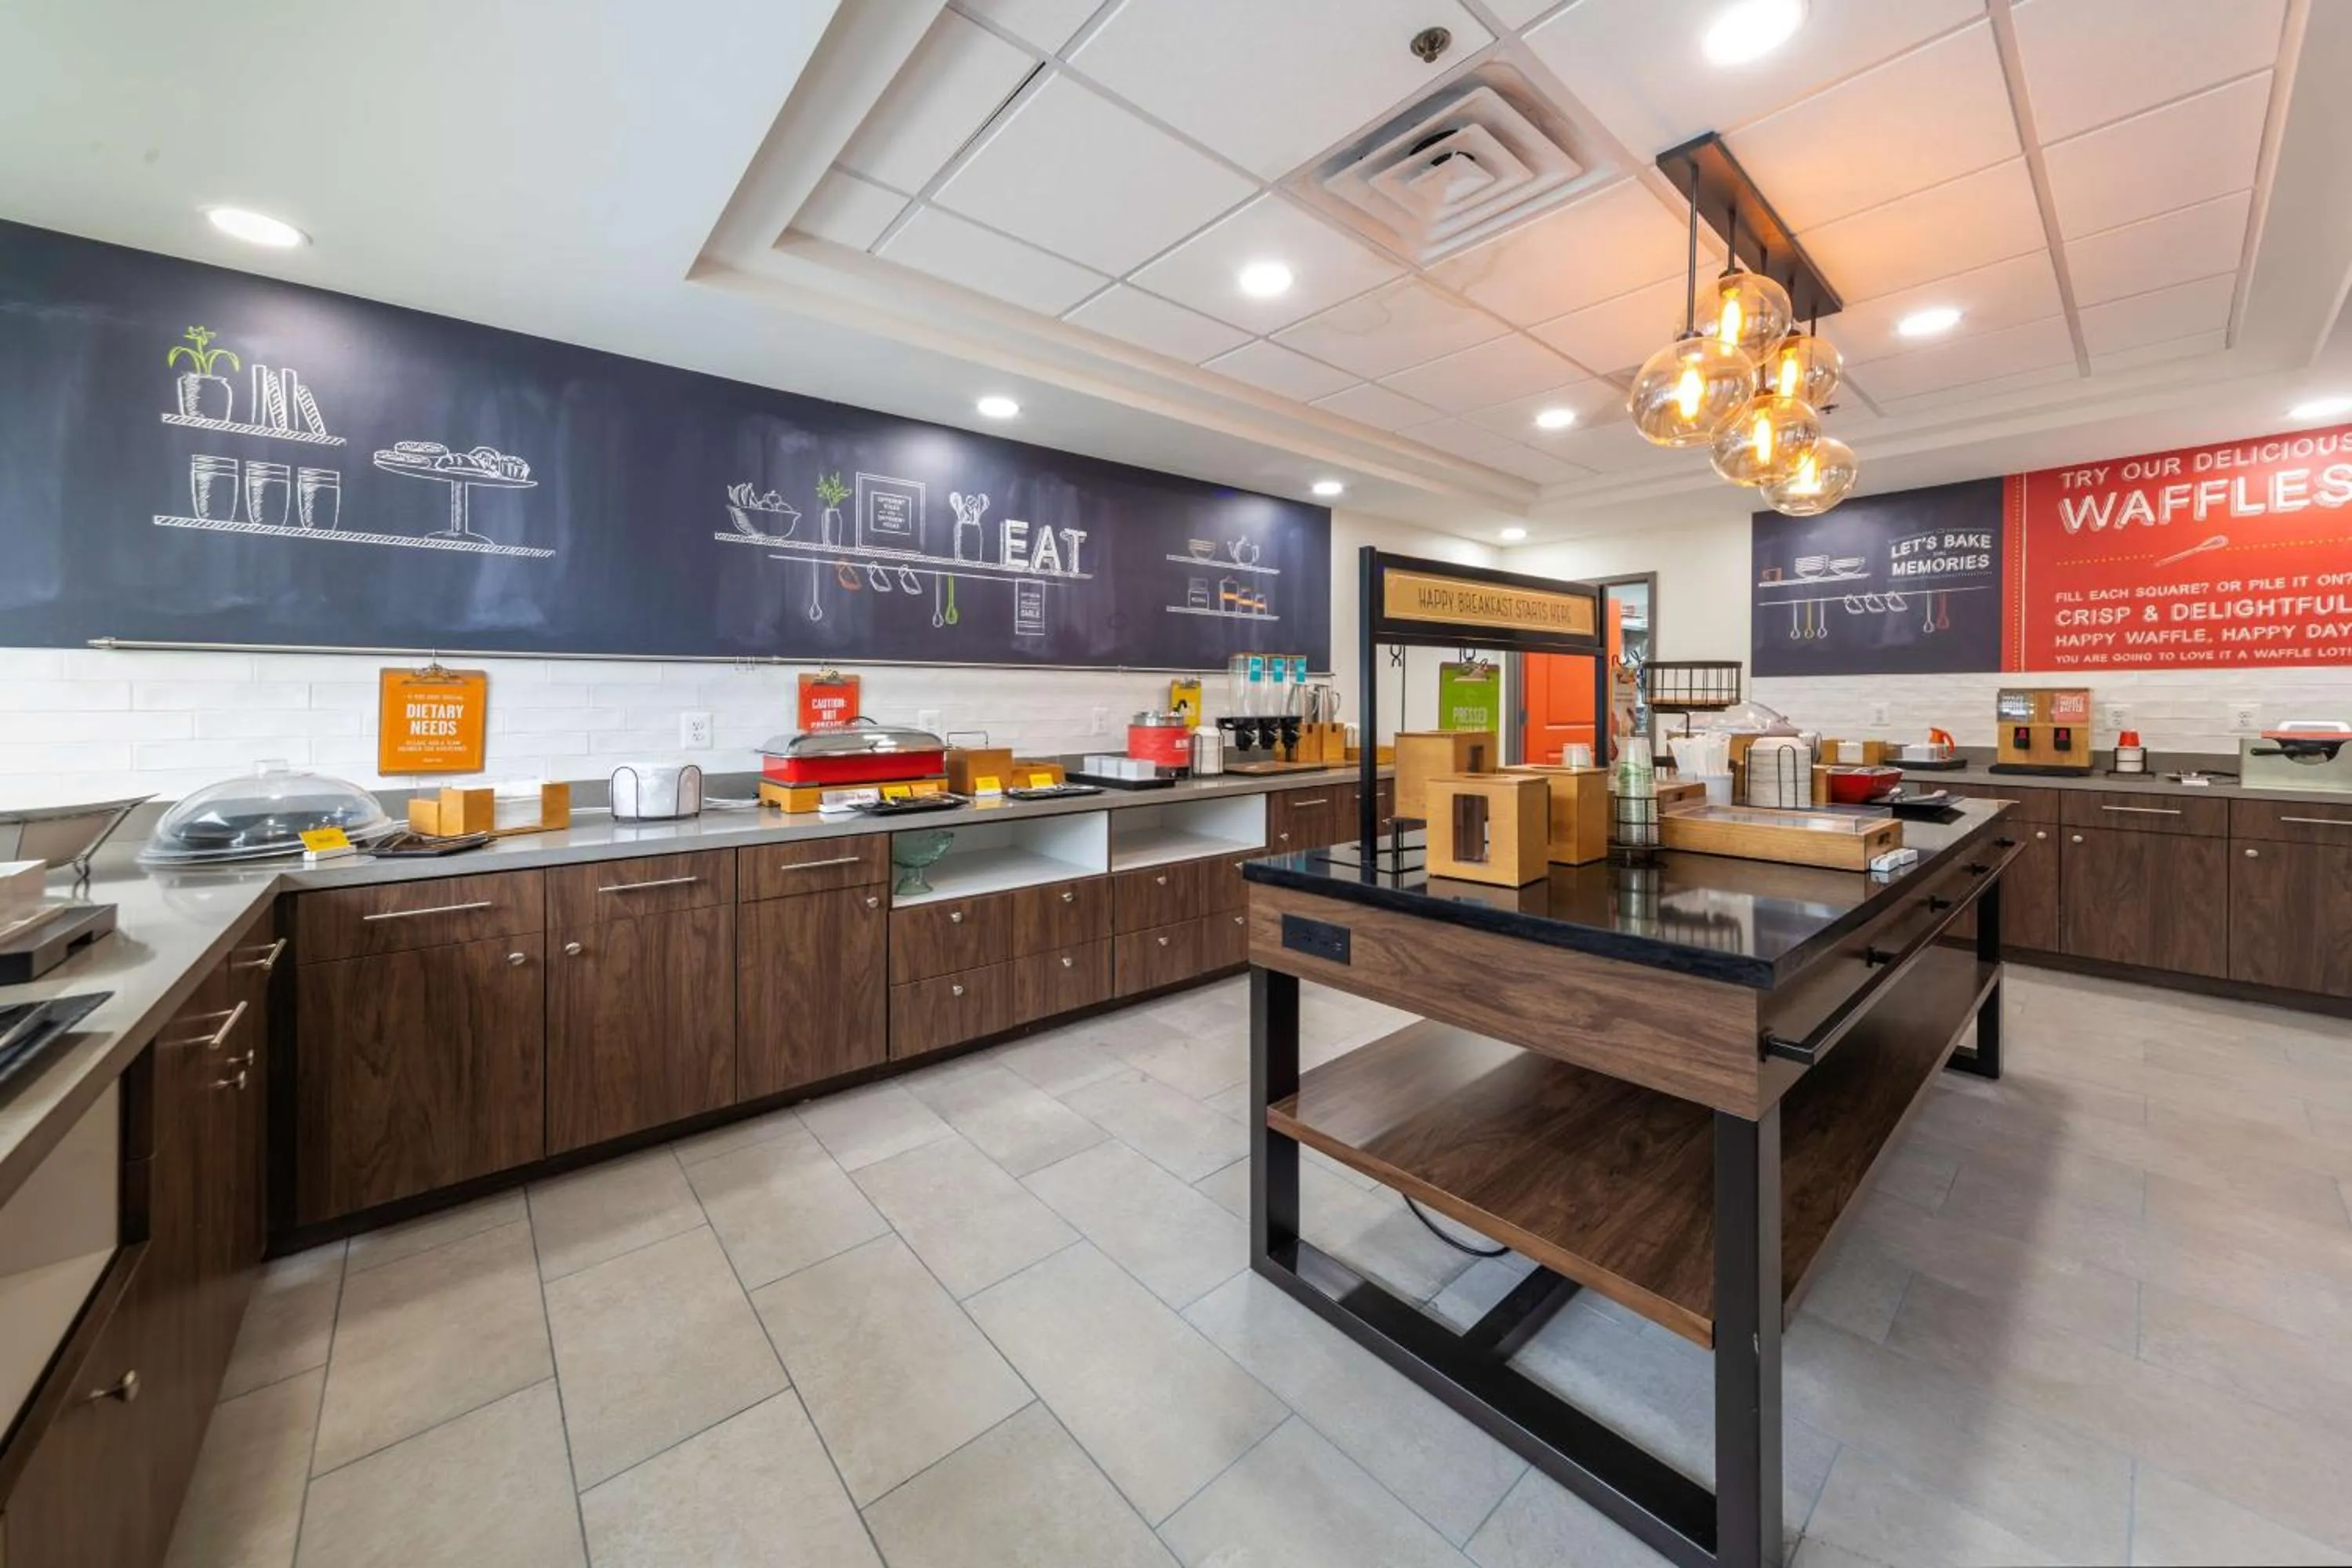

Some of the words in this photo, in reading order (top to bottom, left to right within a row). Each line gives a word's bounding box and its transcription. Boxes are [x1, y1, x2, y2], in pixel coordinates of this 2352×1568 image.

[2060, 466, 2110, 490] TRY
[2121, 456, 2182, 481] OUR
[2057, 463, 2352, 535] WAFFLES
[1000, 519, 1087, 573] EAT
[1890, 535, 1938, 559] LET'S
[1944, 533, 1992, 549] BAKE
[1891, 554, 1991, 577] MEMORIES
[2056, 591, 2083, 603] FILL
[2089, 589, 2129, 601] EACH
[2135, 582, 2209, 598] SQUARE?
[2216, 580, 2242, 593] OR
[2248, 576, 2286, 590] PILE
[2292, 575, 2309, 587] IT
[1418, 587, 1454, 612] HAPPY
[1457, 592, 1513, 618] BREAKFAST
[1515, 600, 1548, 622] STARTS
[1550, 602, 1572, 624] HERE
[2055, 606, 2131, 627] CRISP
[2143, 604, 2158, 622] &
[2170, 593, 2352, 622] DELIGHTFUL
[2055, 632, 2116, 648] HAPPY
[2221, 624, 2296, 641] HAPPY
[2305, 621, 2352, 639] DAY
[2055, 654, 2079, 664] YOU
[2083, 653, 2108, 663] ARE
[2112, 652, 2153, 662] GOING
[2158, 652, 2175, 661] TO
[2180, 650, 2214, 661] LOVE
[2220, 650, 2232, 660] IT
[2237, 649, 2248, 659] A
[2252, 647, 2312, 659] WAFFLE
[406, 702, 465, 719] DIETARY
[410, 720, 457, 736] NEEDS
